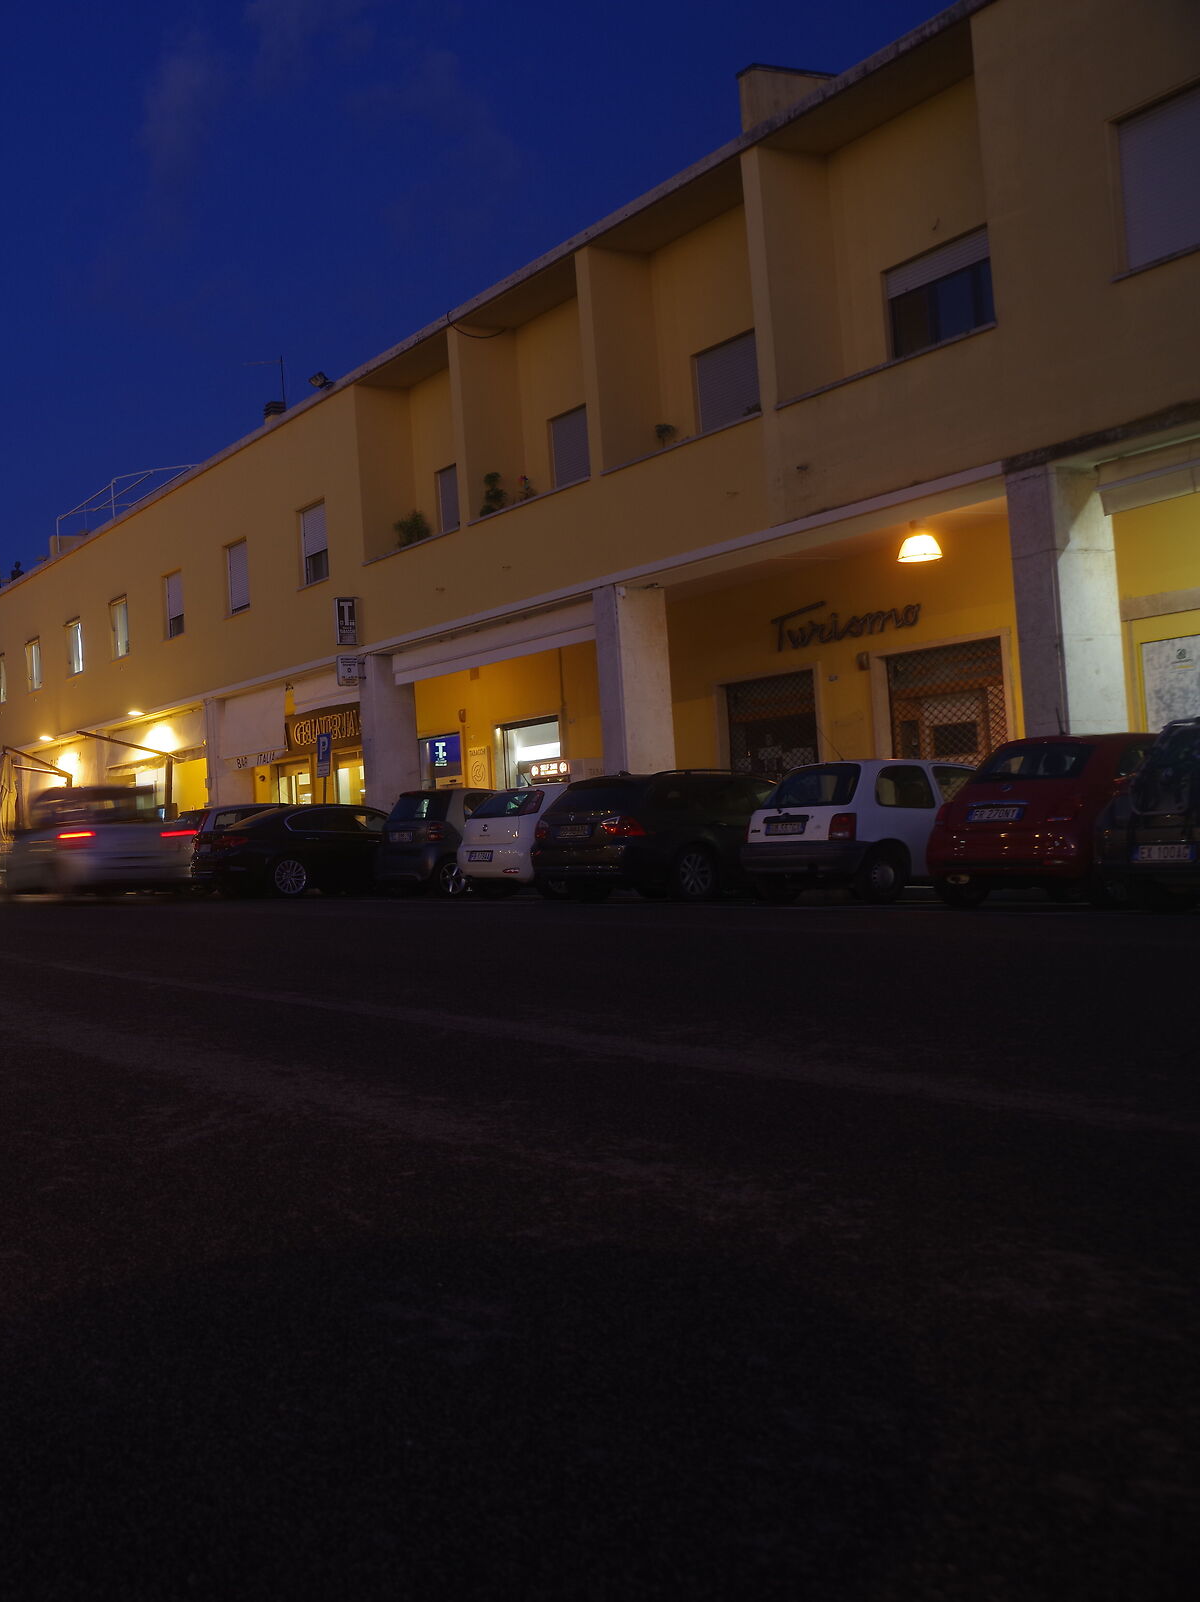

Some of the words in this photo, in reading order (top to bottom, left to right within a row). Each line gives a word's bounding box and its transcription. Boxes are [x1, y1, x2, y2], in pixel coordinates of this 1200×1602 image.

[770, 600, 921, 652] Turismo
[319, 736, 328, 760] P
[236, 756, 248, 769] BAR
[256, 752, 276, 766] ITALIA
